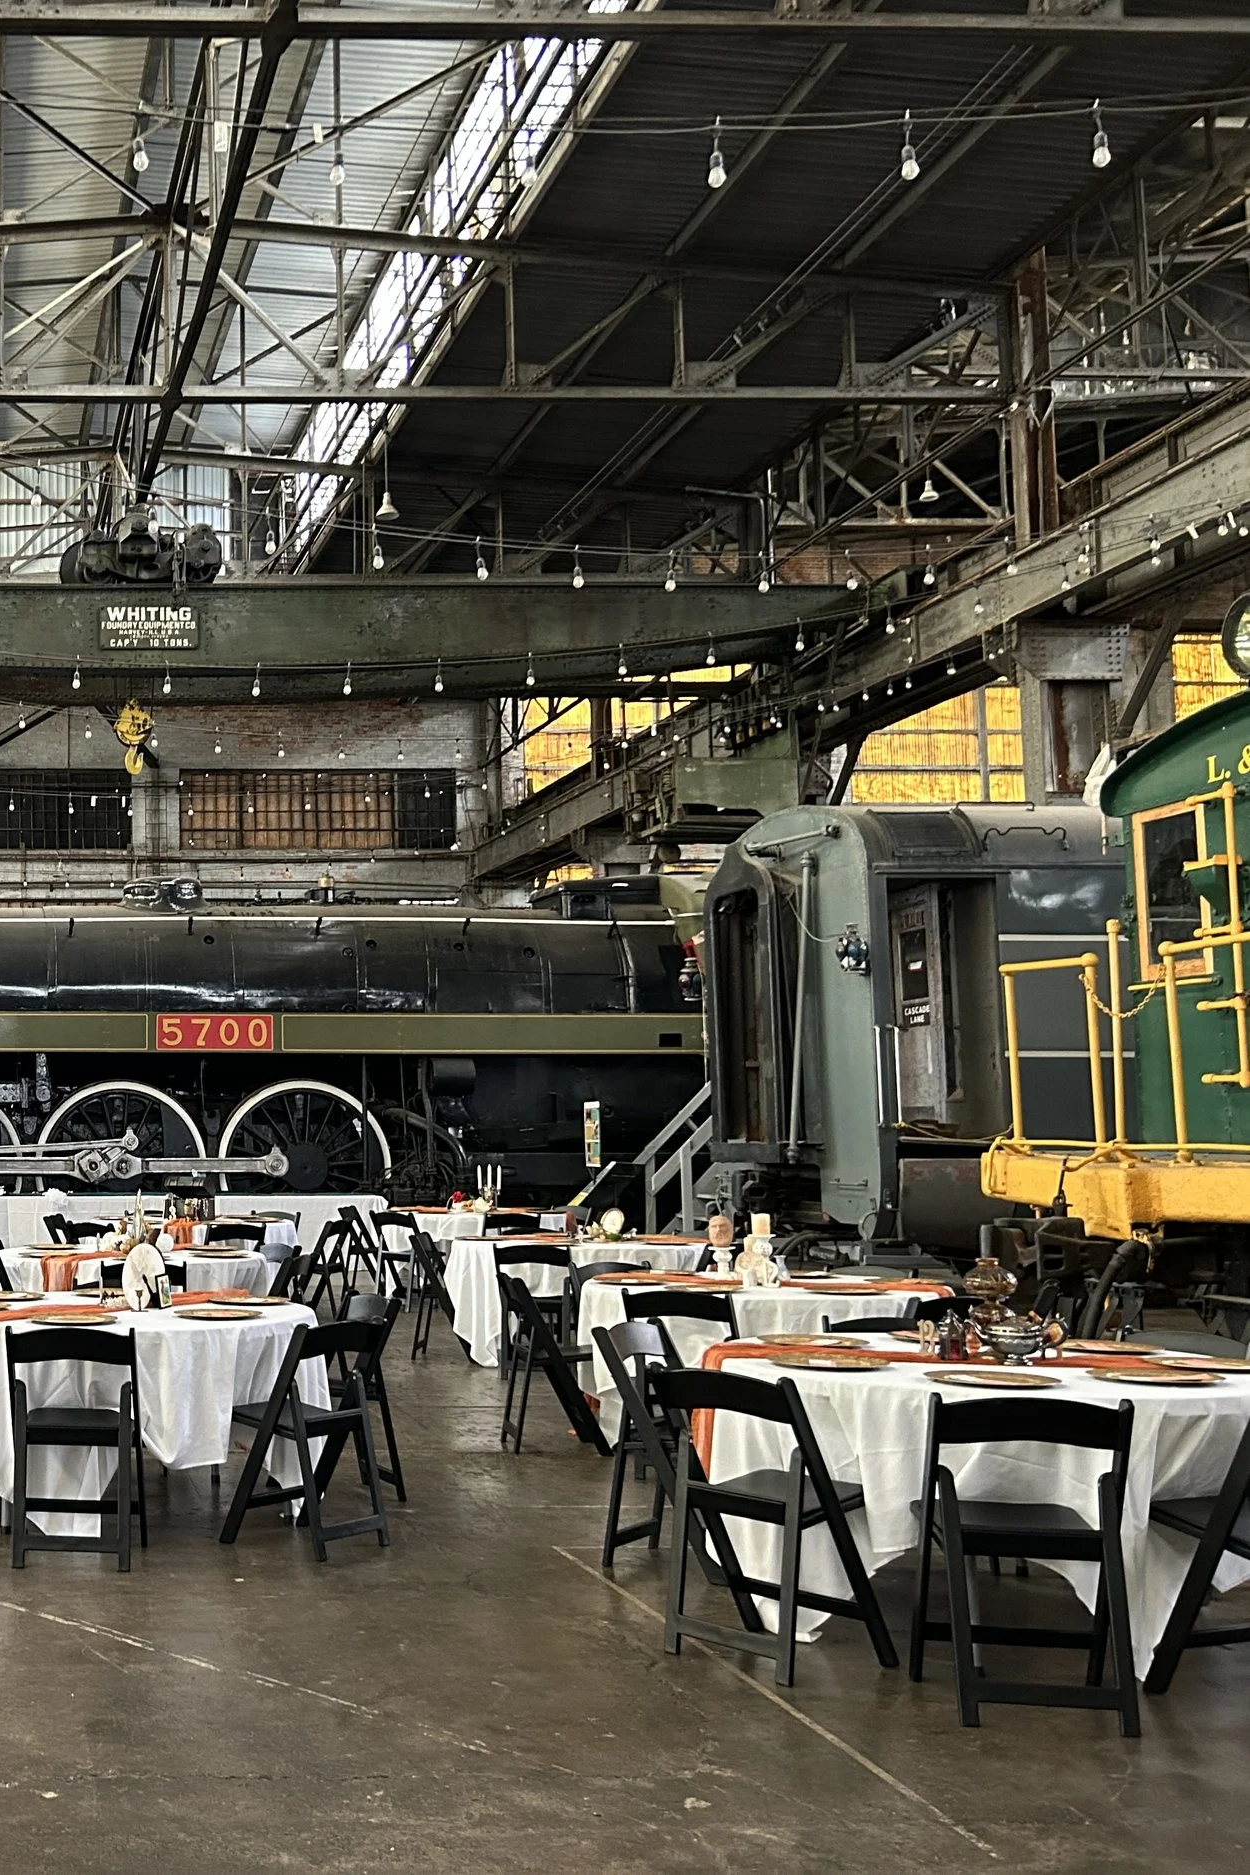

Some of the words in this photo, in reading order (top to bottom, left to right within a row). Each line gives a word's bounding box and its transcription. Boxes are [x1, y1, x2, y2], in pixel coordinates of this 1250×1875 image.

[107, 606, 191, 621] WHITING
[101, 621, 137, 630] FOUNDRY
[138, 621, 184, 630] EQUIPMENT
[150, 638, 160, 647] 10
[904, 1004, 930, 1016] CASCADE
[910, 1014, 925, 1024] LANE
[162, 1018, 268, 1047] 5700
